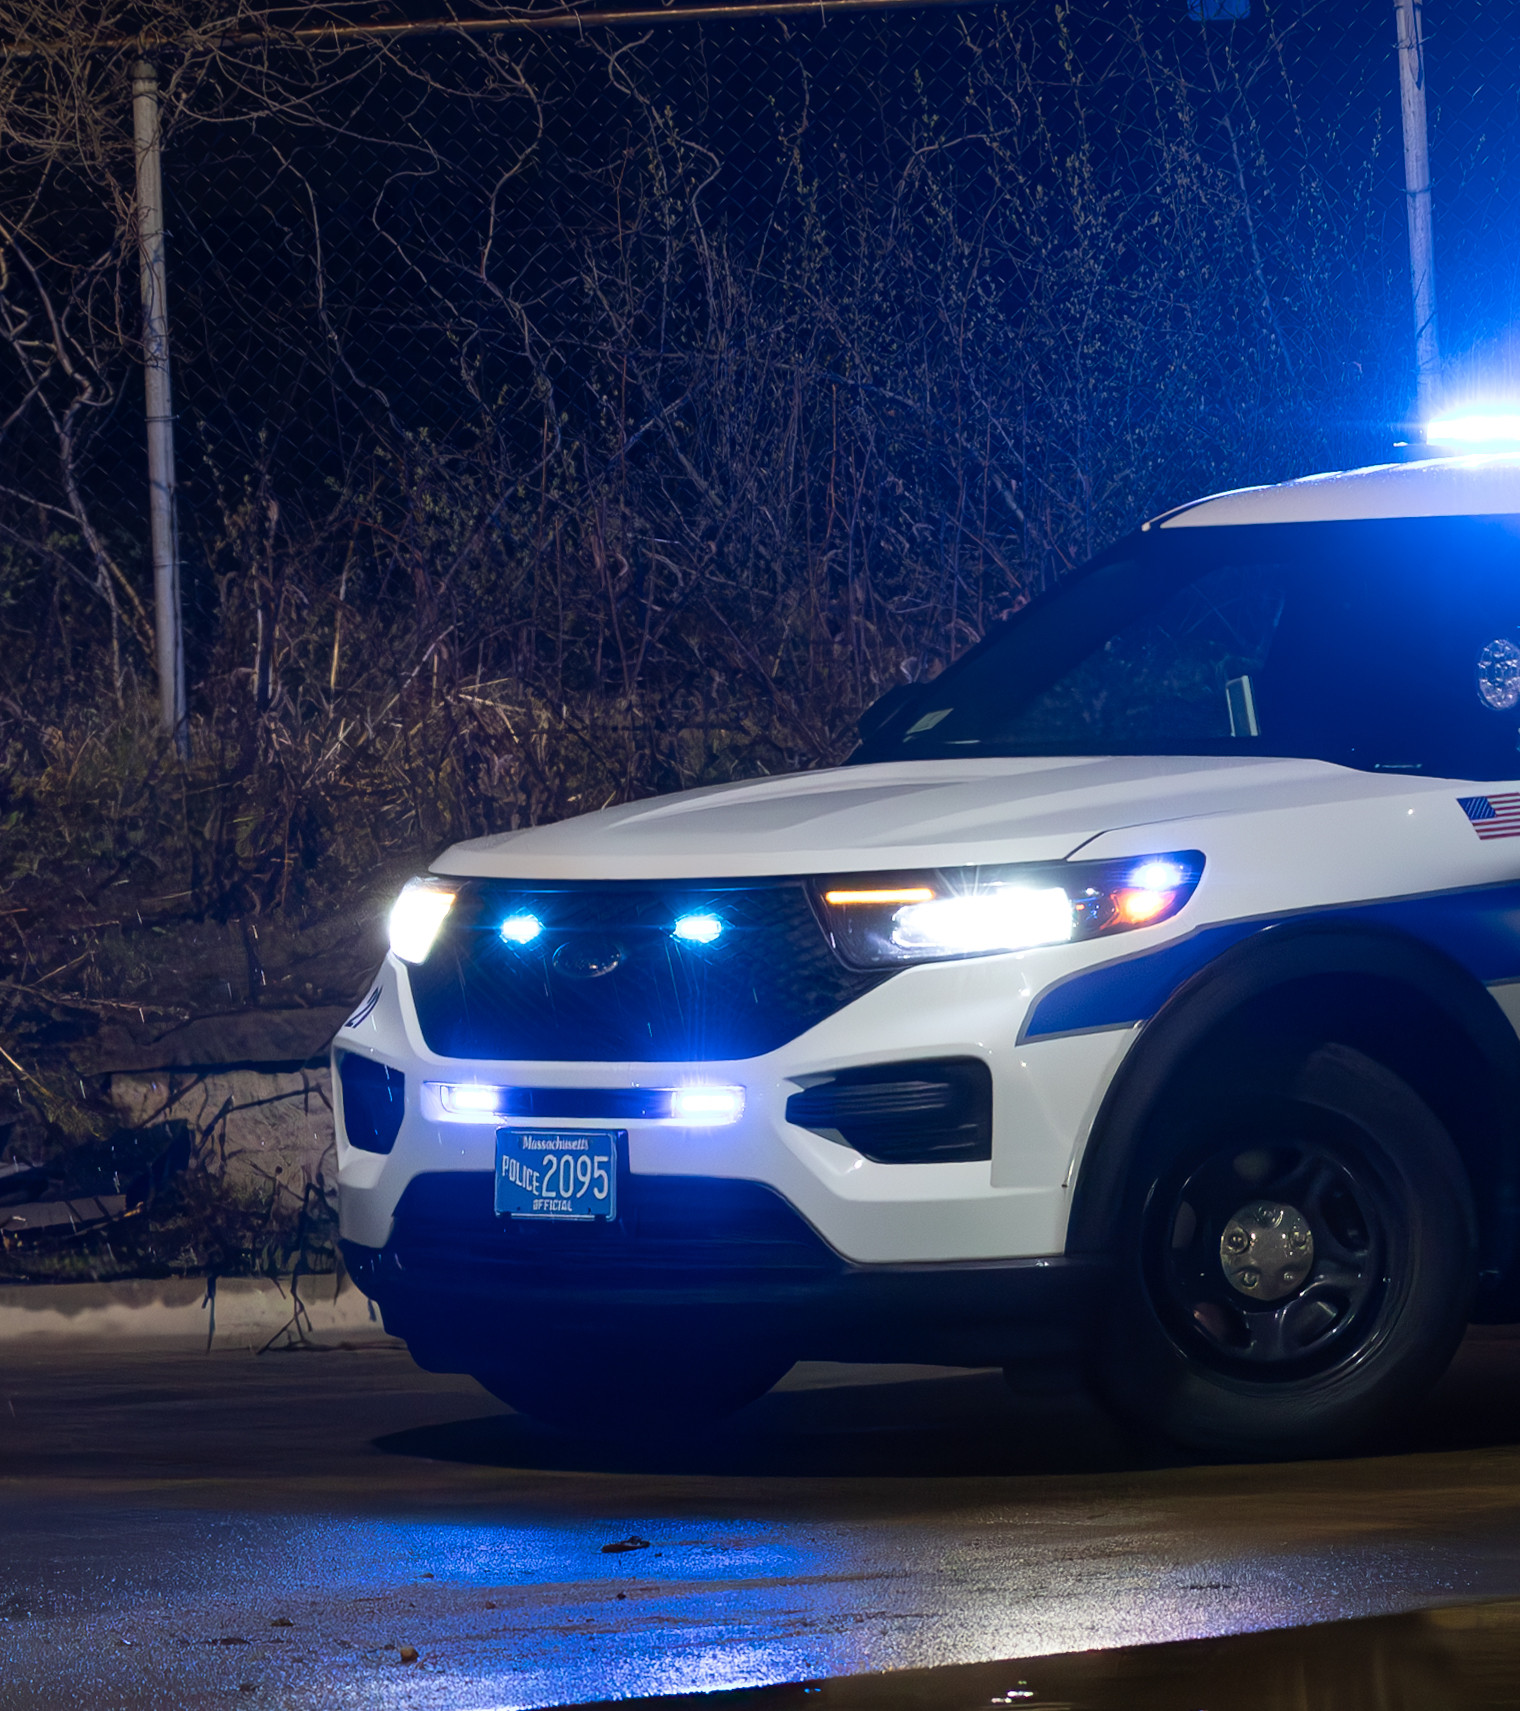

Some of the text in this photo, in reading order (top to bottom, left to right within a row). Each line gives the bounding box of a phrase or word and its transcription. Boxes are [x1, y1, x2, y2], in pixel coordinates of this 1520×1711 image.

[522, 1135, 589, 1151] Massachusetts
[502, 1154, 609, 1200] POLICE 2095
[532, 1199, 573, 1212] OFFICIAL
